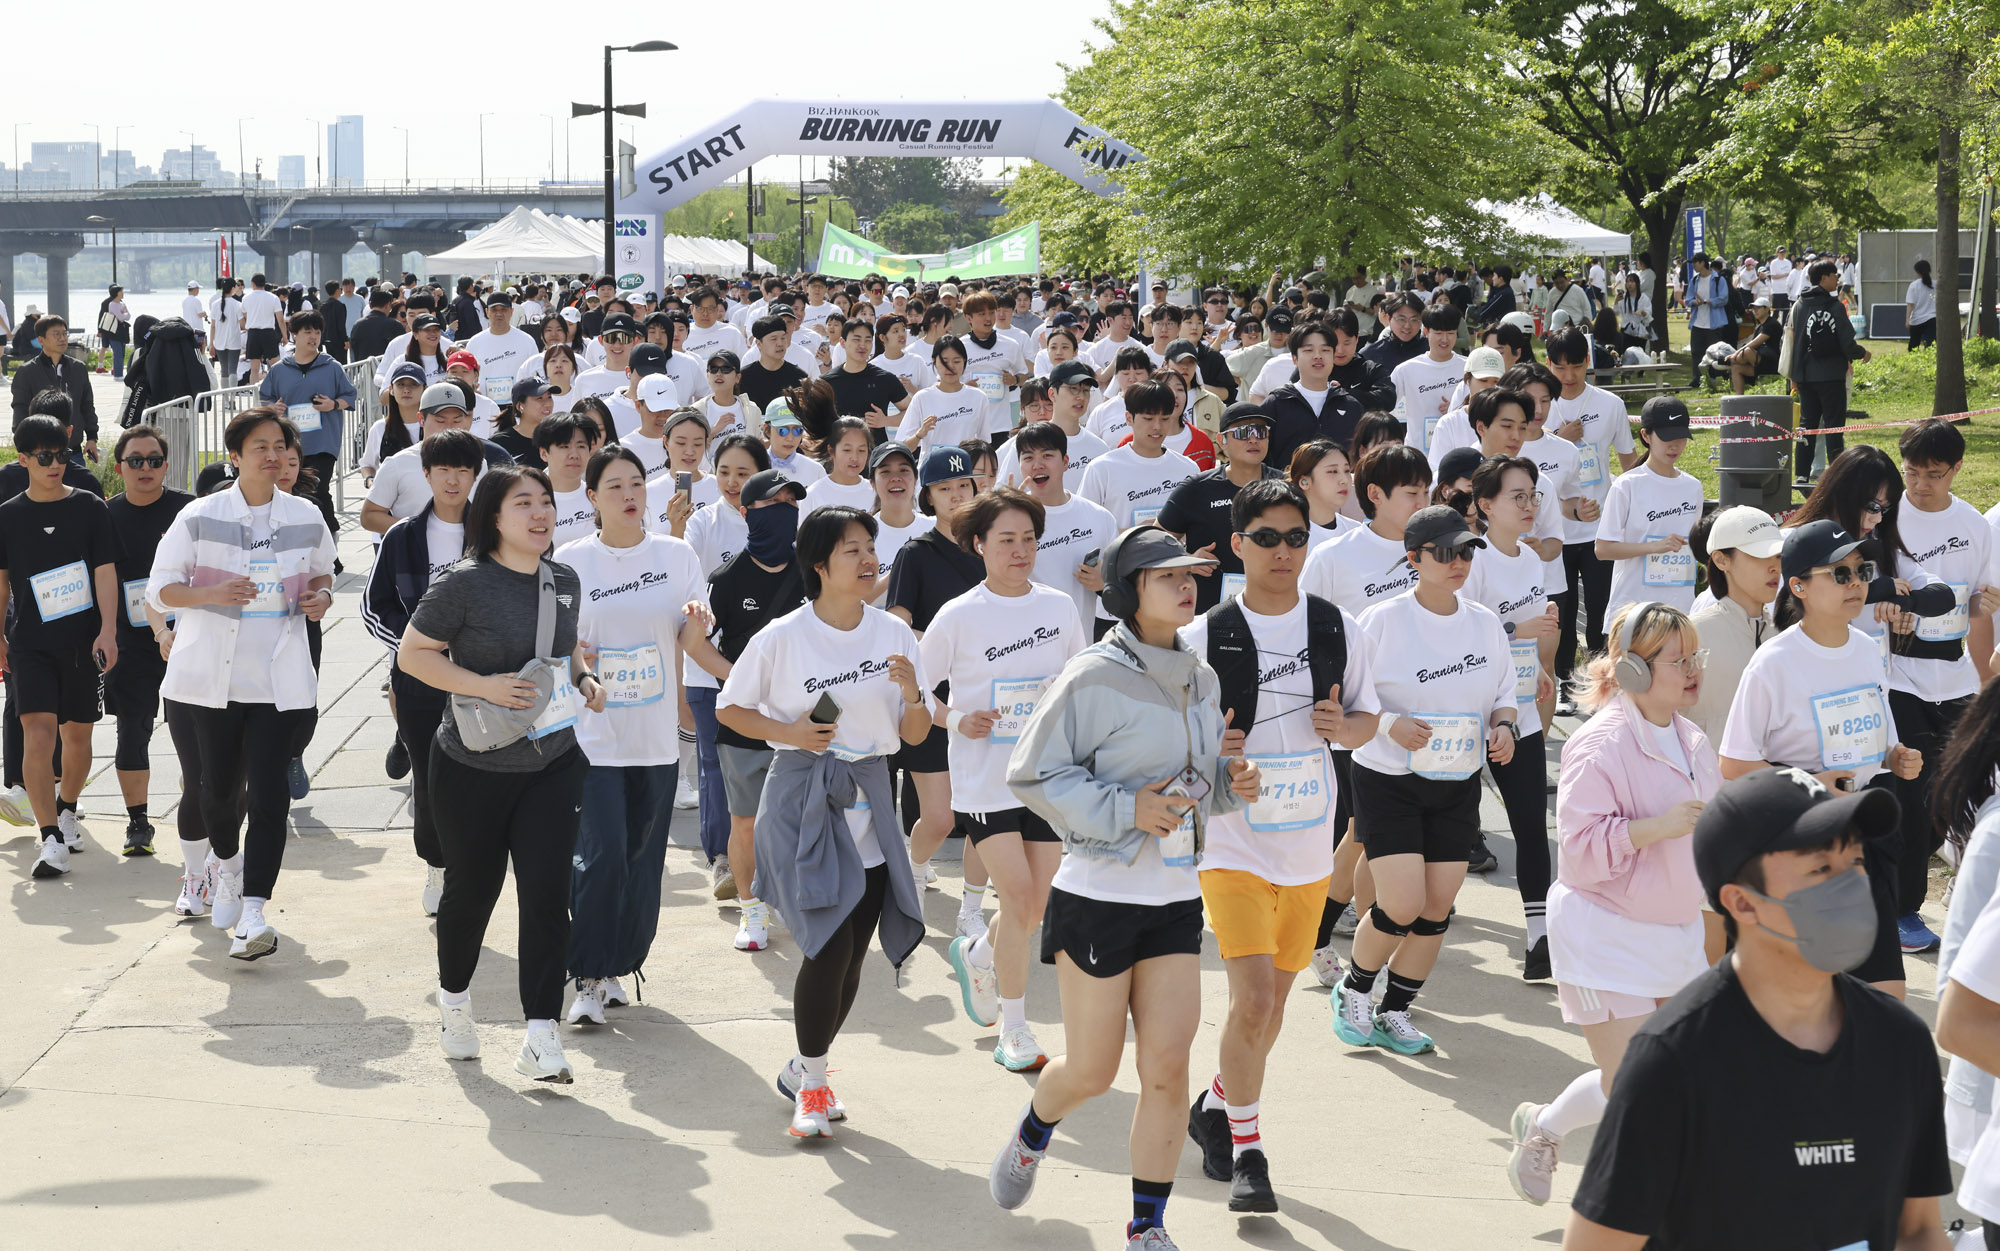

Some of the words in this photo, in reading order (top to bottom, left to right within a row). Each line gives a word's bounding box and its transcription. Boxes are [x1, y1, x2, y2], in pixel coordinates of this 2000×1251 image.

[799, 117, 932, 142] BURNING
[936, 119, 1002, 142] RUN
[928, 143, 961, 151] Running
[649, 124, 746, 195] START
[968, 355, 990, 366] Burning
[990, 351, 1003, 361] Run
[1418, 381, 1448, 394] Burning
[131, 386, 143, 407] DAUNT
[125, 407, 136, 427] BOOKS
[958, 406, 974, 417] Run
[1580, 413, 1600, 425] Run
[712, 427, 737, 440] urning
[1538, 462, 1559, 472] Run
[1127, 485, 1163, 502] Burning
[1210, 498, 1233, 509] HOKA
[1646, 506, 1683, 522] Burning
[1069, 528, 1093, 541] Run
[1947, 536, 1969, 553] Run
[1651, 555, 1659, 563] W
[1660, 554, 1691, 566] 8328
[42, 591, 51, 600] M
[51, 579, 84, 598] 7200
[589, 581, 640, 602] Burning
[640, 571, 669, 587] Run
[1364, 576, 1409, 598] Burning
[132, 599, 140, 607] M
[1498, 594, 1534, 615] Burning
[985, 634, 1035, 662] Burning
[1034, 626, 1061, 644] Run
[1218, 644, 1243, 652] SALOMON
[604, 671, 615, 680] W
[616, 664, 657, 682] 8115
[1416, 662, 1464, 684] Burning
[1463, 654, 1488, 669] Run
[1514, 664, 1536, 679] 221
[804, 669, 860, 694] Burning
[859, 660, 890, 677] Run
[613, 691, 638, 699] F-158
[999, 683, 1026, 692] BURNING
[1026, 683, 1040, 691] RUN
[1000, 705, 1012, 716] W
[1013, 702, 1034, 717] 83
[1820, 697, 1847, 709] BURNING
[998, 720, 1018, 730] E-20
[1828, 723, 1840, 736] W
[1843, 712, 1882, 736] 8260
[1431, 738, 1475, 752] 8119
[1288, 760, 1303, 768] RUN
[1832, 752, 1853, 762] E-90
[1257, 785, 1270, 797] M
[1274, 779, 1320, 800] 7149
[1794, 1144, 1856, 1166] WHITE
